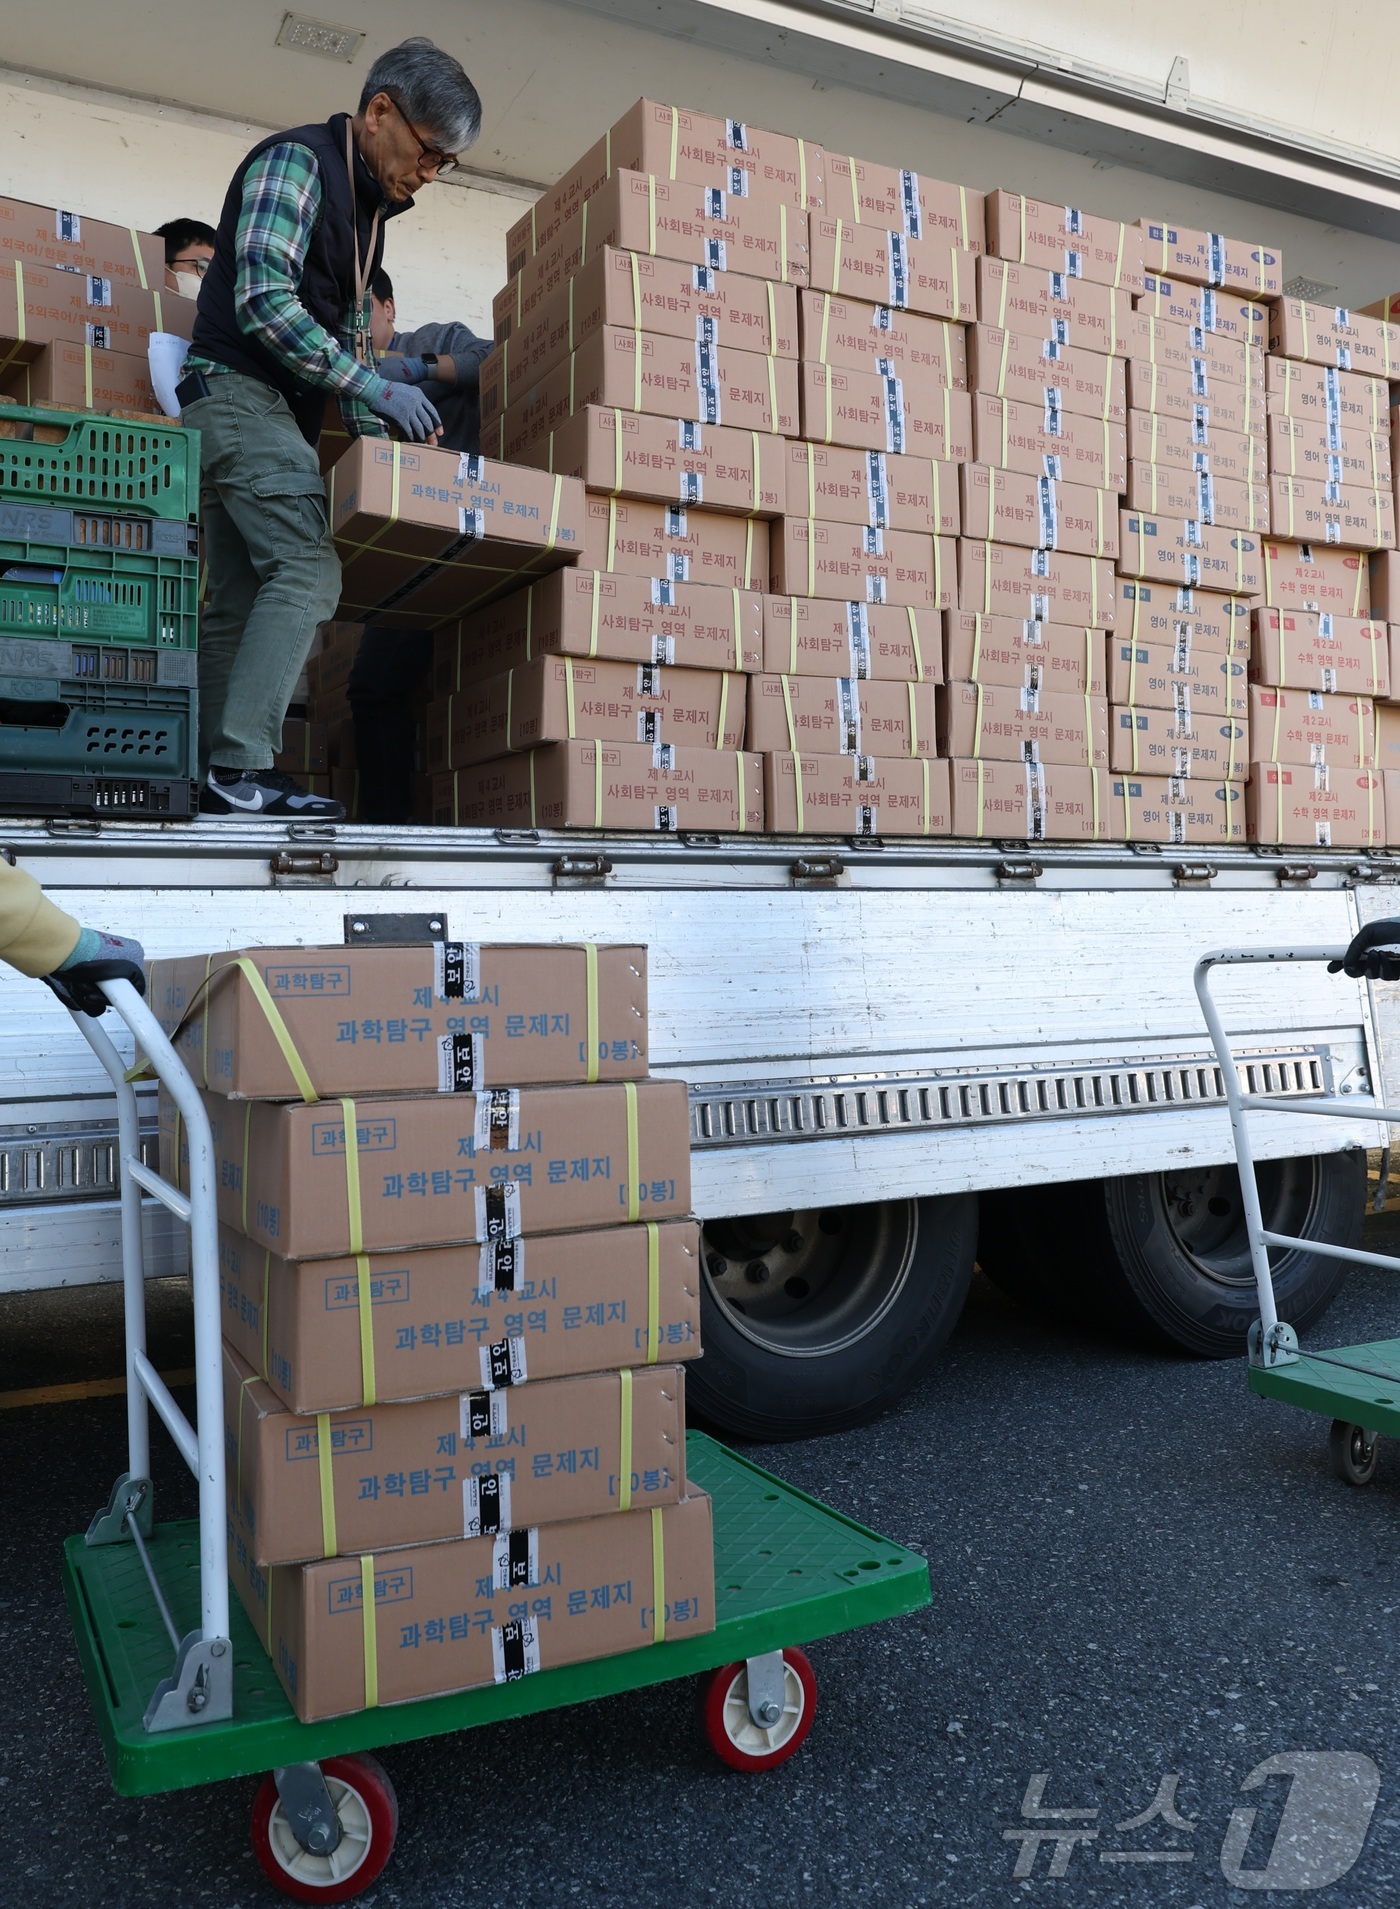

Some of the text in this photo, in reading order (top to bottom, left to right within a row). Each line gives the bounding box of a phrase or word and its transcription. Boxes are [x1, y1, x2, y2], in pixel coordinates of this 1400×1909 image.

[681, 144, 728, 168] 사회탐구
[763, 165, 797, 186] 문제지
[928, 212, 957, 231] 문제지
[657, 216, 705, 239] 사회탐구
[743, 236, 777, 254] 문제지
[1028, 232, 1066, 250] 사회탐구
[73, 252, 95, 269] 영역
[103, 261, 136, 279] 문제지
[1176, 252, 1200, 266] 한국사
[843, 258, 948, 293] 사회탐구 문제지
[642, 293, 764, 329] 사회탐구 영역 문제지
[1009, 297, 1048, 315] 사회탐구
[1078, 314, 1106, 330] 문제지
[1170, 305, 1192, 320] 한국사
[889, 329, 908, 344] 교시
[836, 334, 940, 368] 사회탐구 영역 문제지
[1354, 343, 1376, 357] 문제지
[641, 372, 765, 406] 사회탐구 문제지
[1008, 363, 1103, 397] 사회탐구 영역 문제지
[837, 405, 943, 437] 사회탐구 문제지
[1008, 435, 1103, 465] 사회탐구 영역 문제지
[625, 451, 751, 483] 사회탐구 영역 문제지
[479, 480, 501, 496] 교시
[816, 482, 928, 509] 사회탐구 문제지
[411, 484, 539, 520] 과학탐구 영역 문제지
[994, 508, 1093, 532] 사회탐구 문제지
[1345, 515, 1367, 528] 문제지
[615, 539, 737, 570] 사회탐구 문제지
[1158, 550, 1229, 572] 영어 문제지
[817, 560, 927, 584] 사회탐구 영역 문제지
[992, 580, 1091, 603] 사회탐구 문제지
[1300, 584, 1316, 594] 영역
[1320, 586, 1343, 599] 문제지
[669, 605, 691, 619] 교시
[602, 615, 730, 642] 사회탐구 영역 문제지
[1151, 616, 1220, 637] 영어 문제지
[797, 637, 911, 658] 사회탐구 문제지
[980, 648, 1020, 664] 사회탐구
[1052, 657, 1080, 672] 문제지
[1318, 655, 1333, 666] 영역
[1338, 657, 1360, 669] 문제지
[1149, 678, 1218, 697] 영어 문제지
[581, 701, 710, 725] 사회탐구 문제지
[1035, 711, 1053, 722] 교시
[871, 719, 904, 733] 문제지
[982, 722, 1084, 742] 사회탐구 영역 문제지
[1307, 732, 1322, 743] 영역
[1326, 734, 1349, 745] 문제지
[1149, 744, 1217, 761] 영어 문제지
[673, 770, 695, 783] 교시
[608, 784, 733, 803] 사회탐구 영역 문제지
[807, 792, 920, 809] 사회탐구 영역 문제지
[983, 799, 1084, 815] 사회탐구 문제지
[1143, 811, 1213, 824] 영어 문제지
[1313, 808, 1328, 820] 영역
[1333, 810, 1356, 820] 문제지
[275, 972, 343, 990] 과학탐구
[336, 1013, 570, 1043] 과학탐구 영역 문제지
[382, 1169, 475, 1198] 과학탐구
[546, 1156, 611, 1181] 문제지
[395, 1301, 627, 1350] 과학탐구 영역 문제지
[294, 1428, 366, 1453] 과탐구
[357, 1470, 456, 1501] 과학탐구
[531, 1447, 600, 1478] 문제지
[399, 1619, 494, 1650] 과학탐구
[567, 1581, 633, 1613] 문제지
